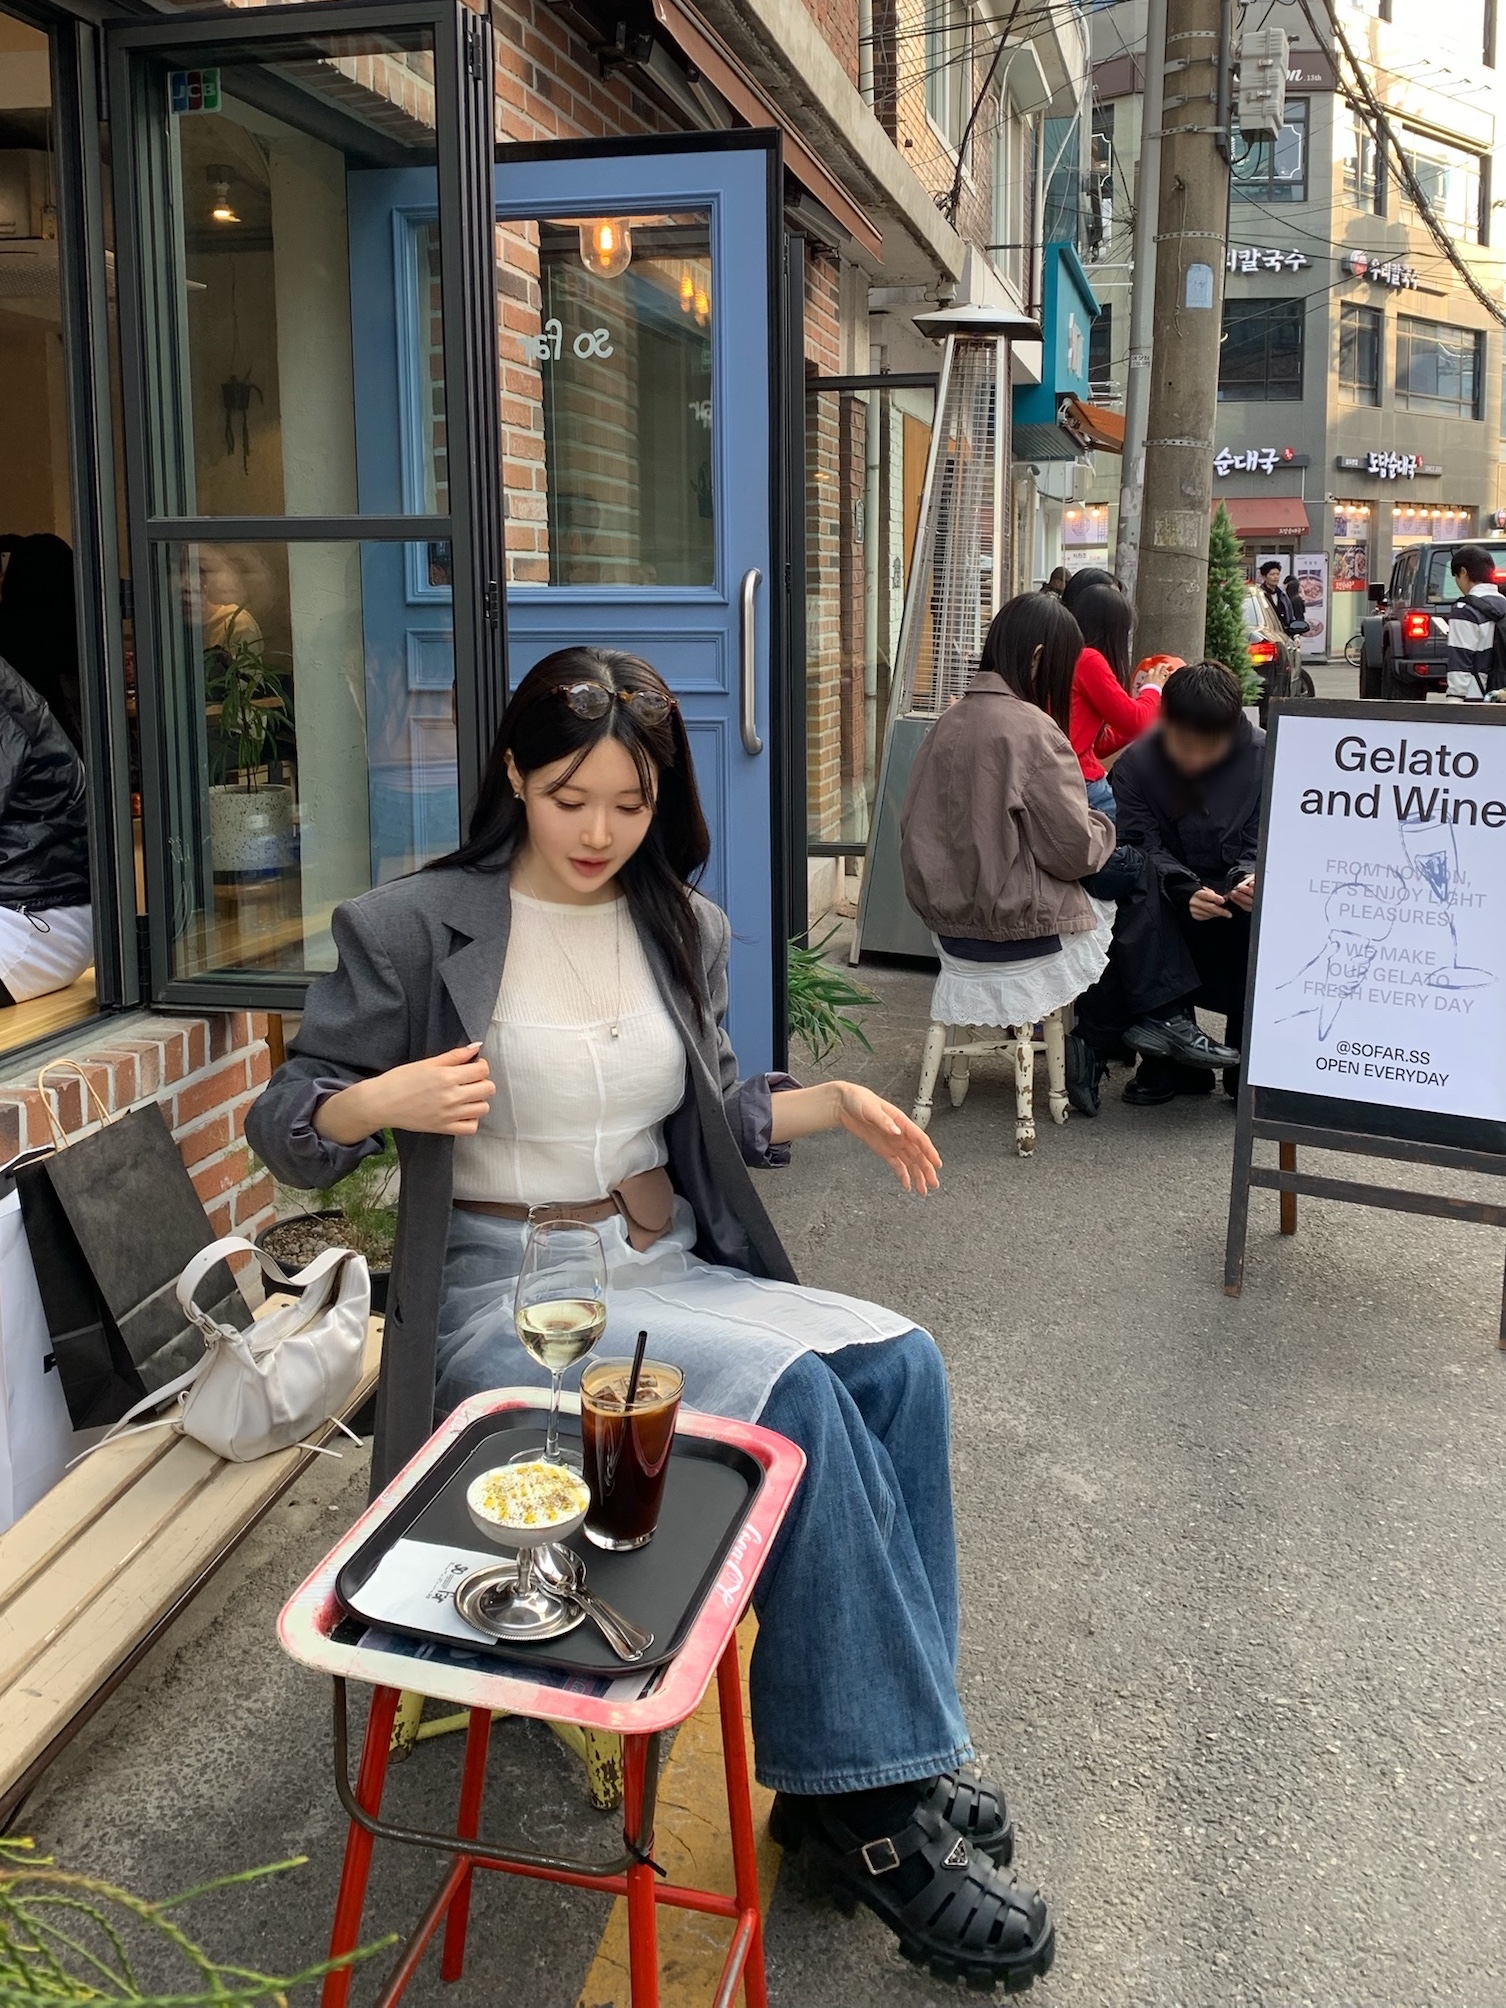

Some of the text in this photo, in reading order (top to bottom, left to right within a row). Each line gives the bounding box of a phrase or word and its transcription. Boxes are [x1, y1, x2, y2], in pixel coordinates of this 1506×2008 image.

[172, 83, 217, 99] JCB
[1213, 446, 1280, 477] 순대국
[1367, 450, 1418, 480] 도담순대국
[1334, 735, 1479, 779] Gelato
[1300, 783, 1506, 828] and Wine
[1326, 859, 1381, 878] FROM
[1363, 883, 1424, 903] ENJOY
[1428, 888, 1488, 909] LGHT
[1338, 902, 1455, 928] PLEASURES!
[1345, 942, 1437, 966] WE MAKE
[1329, 962, 1451, 987] OUR GELATO
[1303, 980, 1475, 1014] FRESH EVERY DAY
[1336, 1040, 1431, 1065] @SOFAR.SS
[1315, 1056, 1450, 1087] OPEN EVERYDAY
